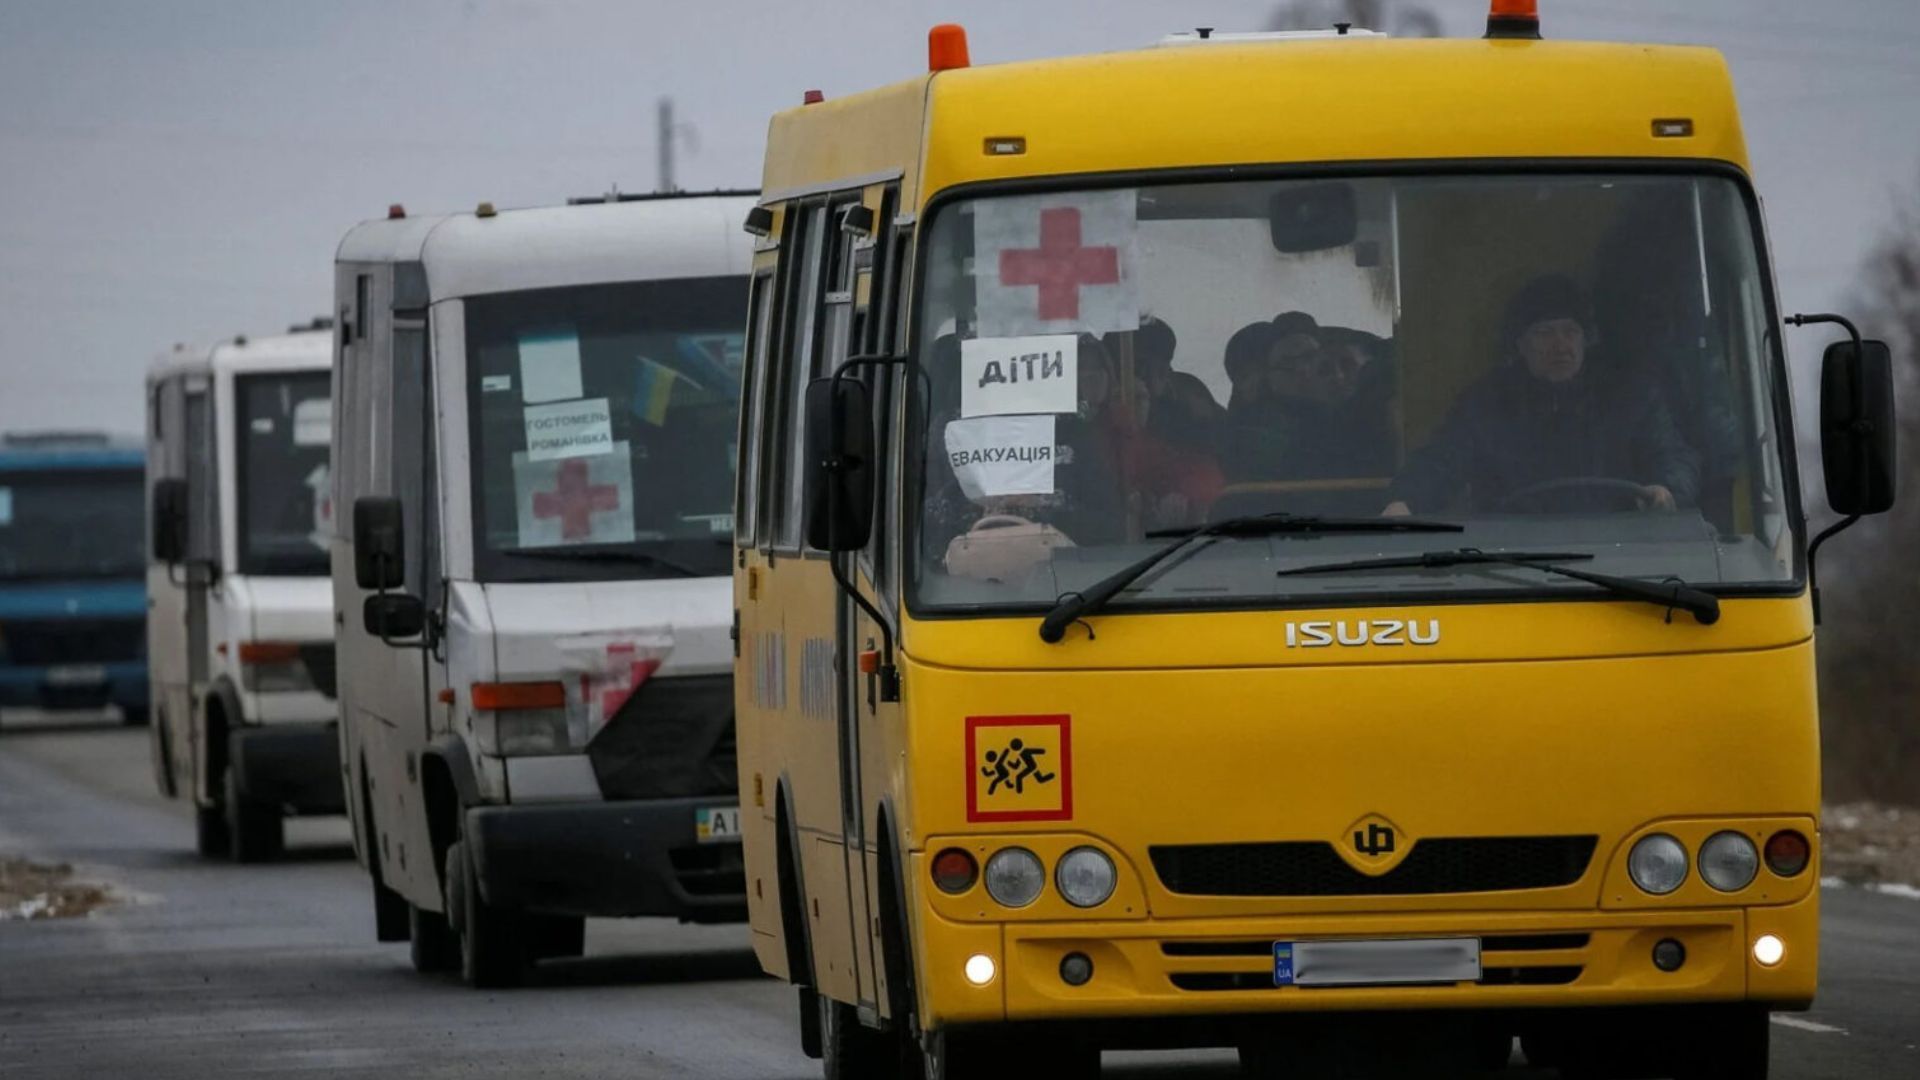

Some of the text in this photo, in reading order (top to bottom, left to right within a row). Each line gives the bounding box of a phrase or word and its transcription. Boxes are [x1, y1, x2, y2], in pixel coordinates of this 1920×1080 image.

[526, 410, 609, 430] ГОСТОМЕЛЬ
[531, 433, 609, 451] РОМАНІВКА
[951, 446, 1051, 468] ЕВАКУАЦІЯ
[1285, 619, 1440, 647] ISUZU
[1277, 968, 1292, 978] UA
